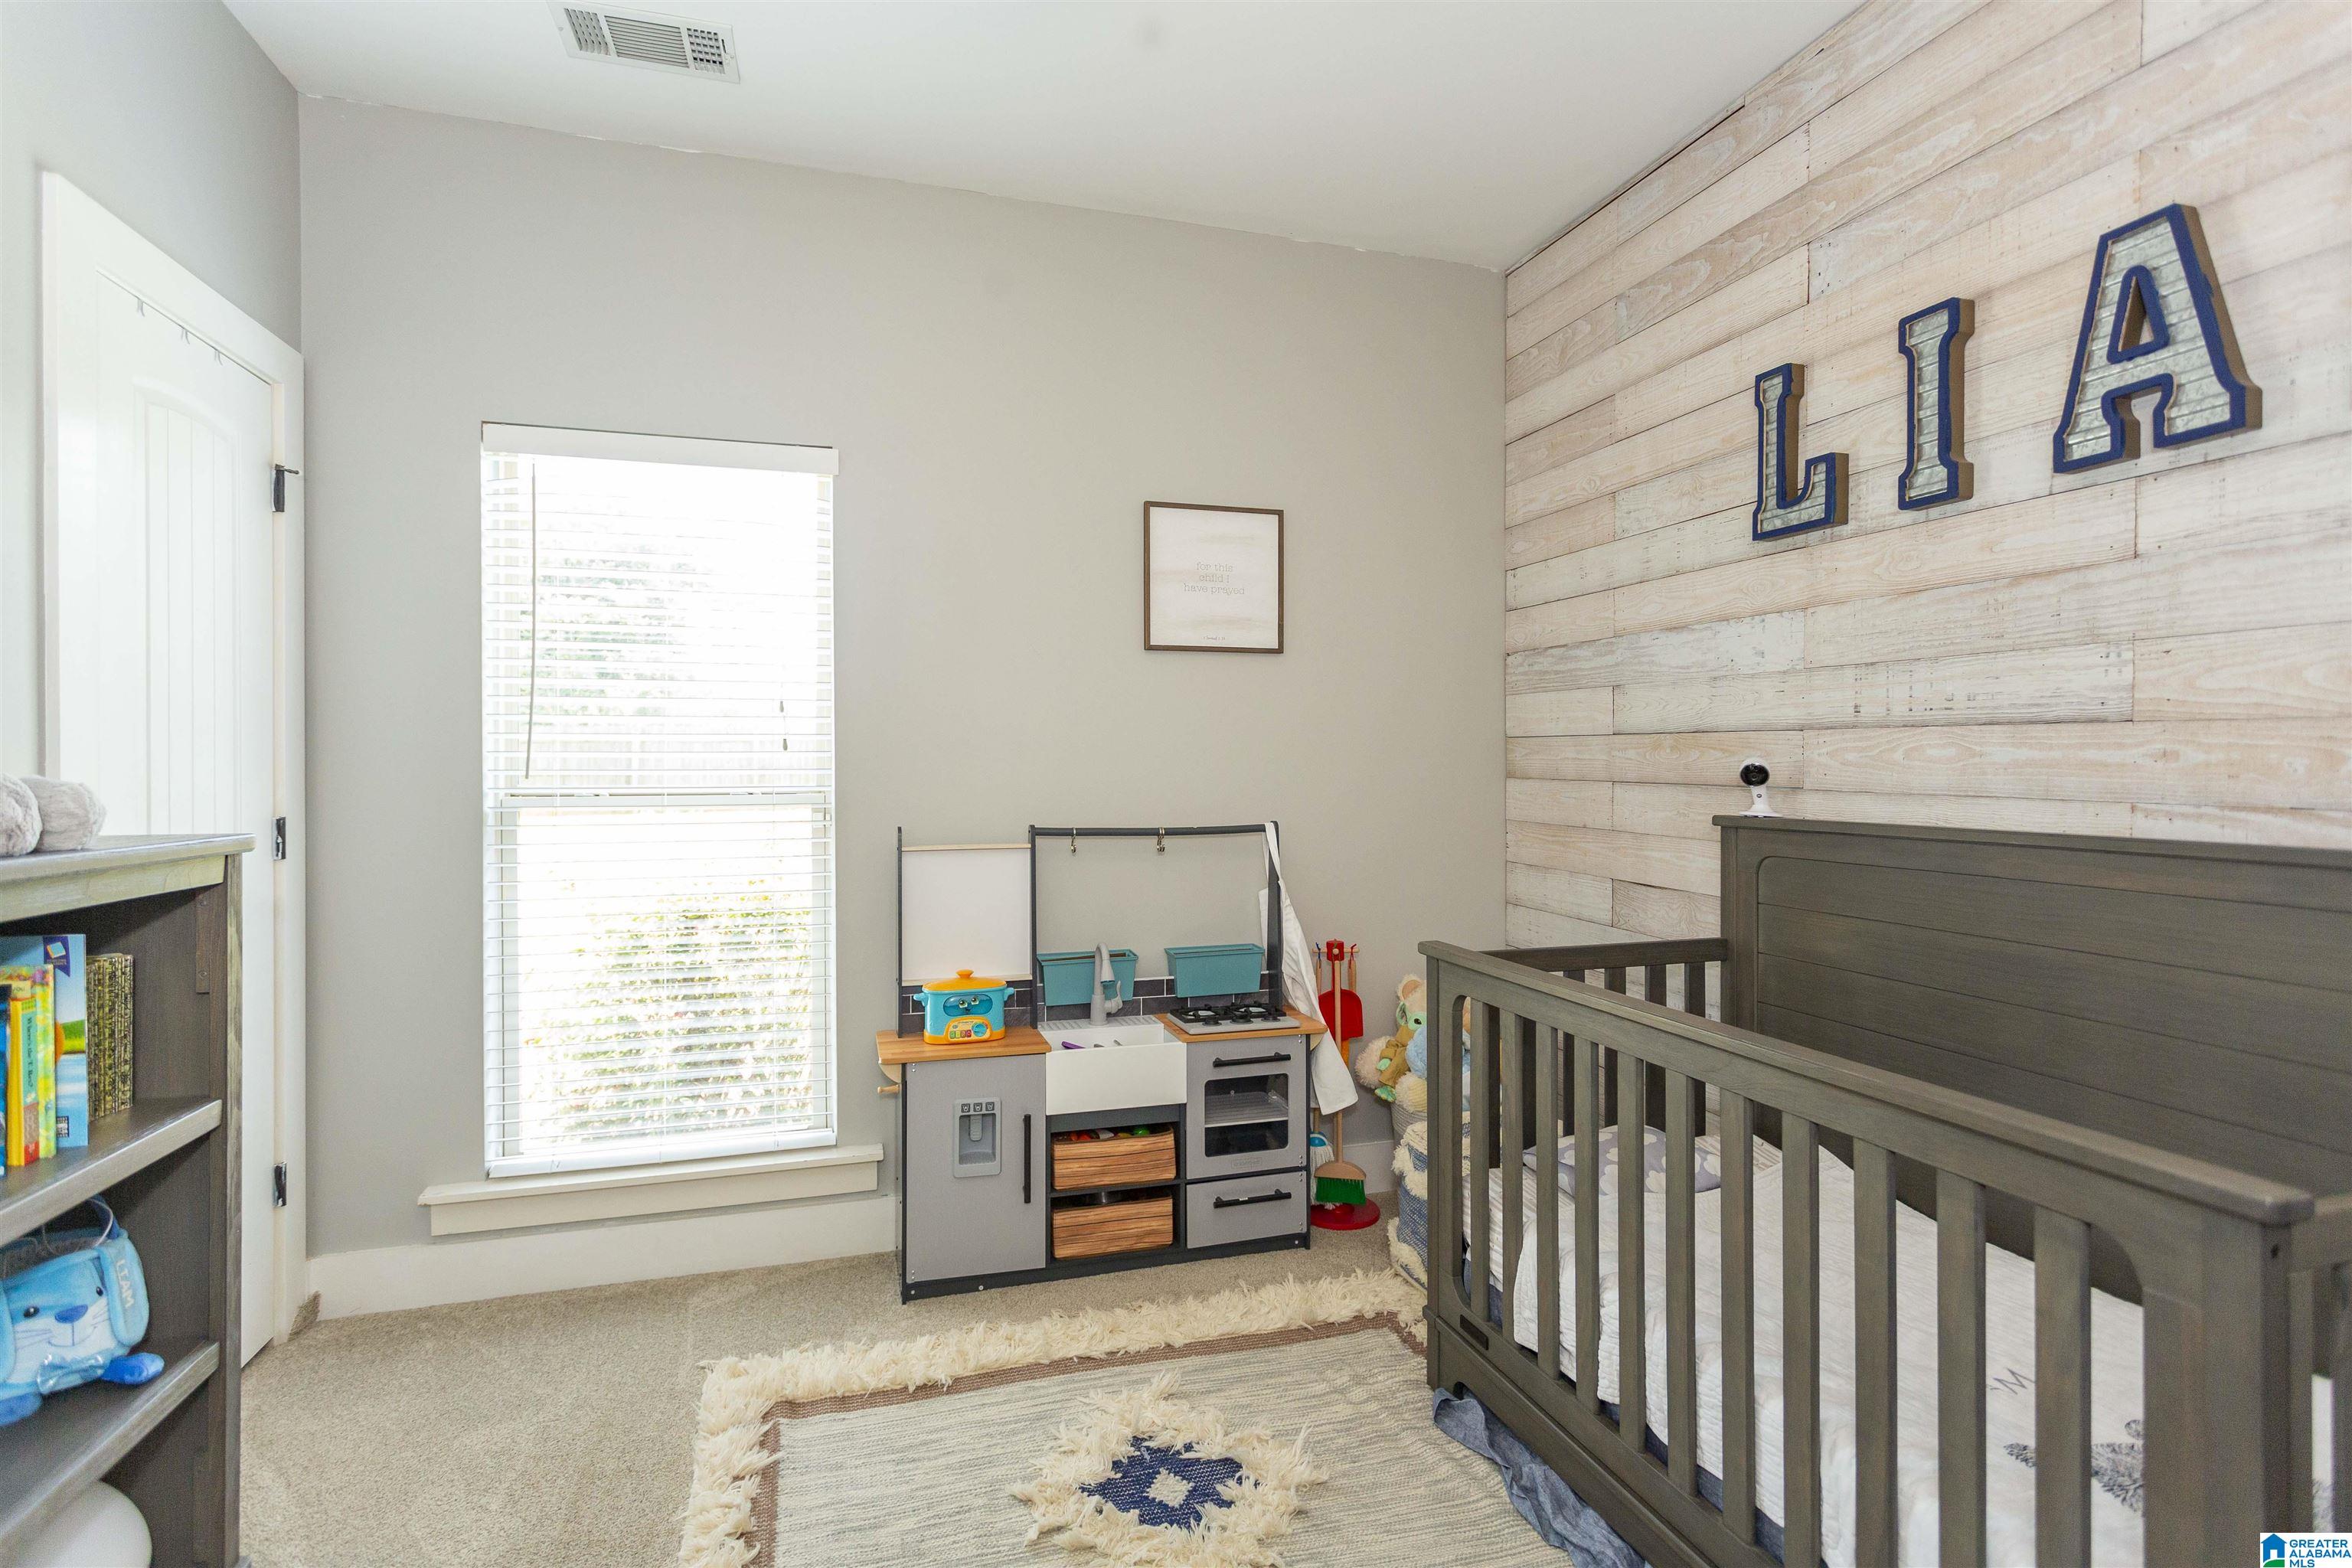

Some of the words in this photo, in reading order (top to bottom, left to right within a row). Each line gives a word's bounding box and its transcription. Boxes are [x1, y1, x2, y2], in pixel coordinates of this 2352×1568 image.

[1197, 561, 1211, 570] for
[1214, 563, 1233, 572] this
[1199, 573, 1223, 582] child
[1184, 581, 1207, 593] have
[1210, 586, 1245, 596] prayed
[116, 1259, 136, 1308] LIAM
